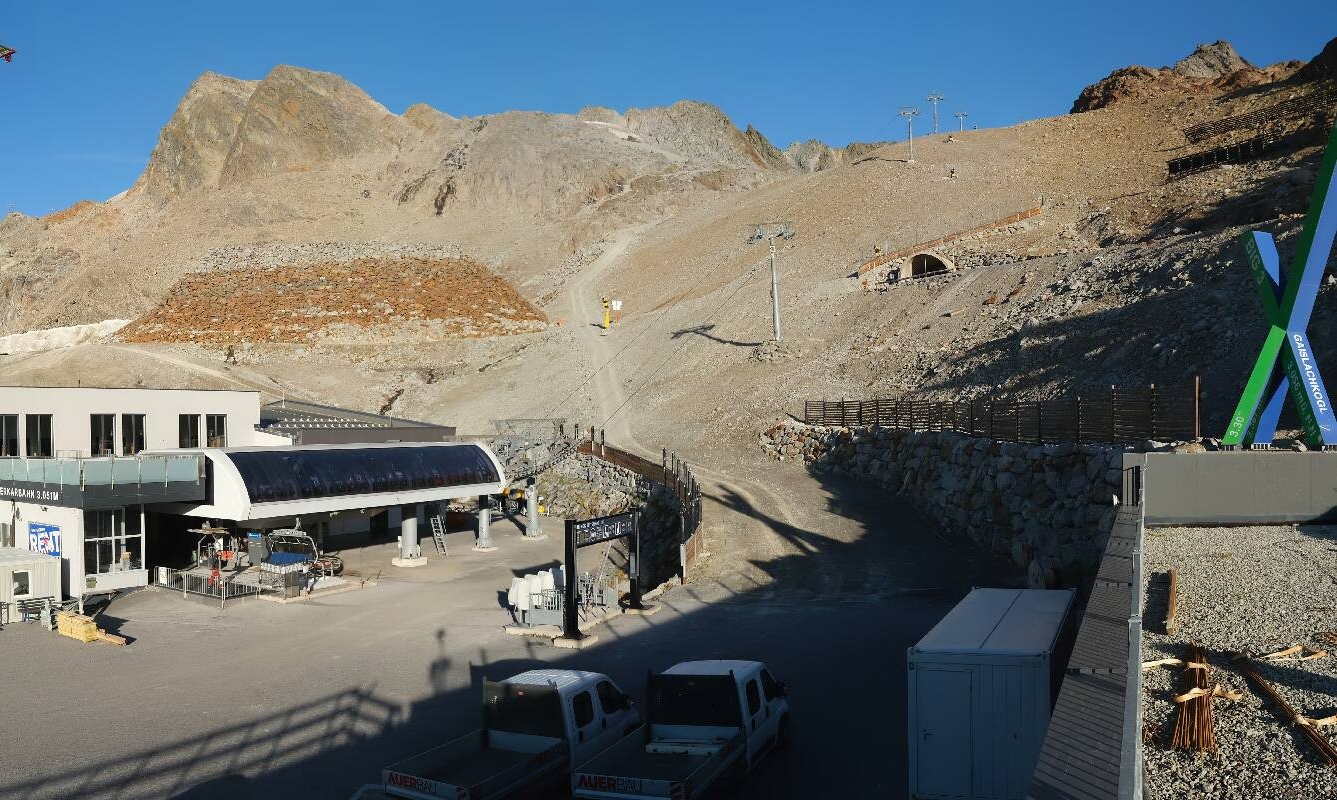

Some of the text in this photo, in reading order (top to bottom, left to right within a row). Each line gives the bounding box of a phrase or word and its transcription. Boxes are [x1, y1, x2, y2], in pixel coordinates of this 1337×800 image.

[1245, 239, 1261, 269] BIG
[1293, 333, 1324, 415] GAISLACHKOGL
[388, 771, 437, 794] AUERBAU
[579, 774, 643, 793] AUERBAU
